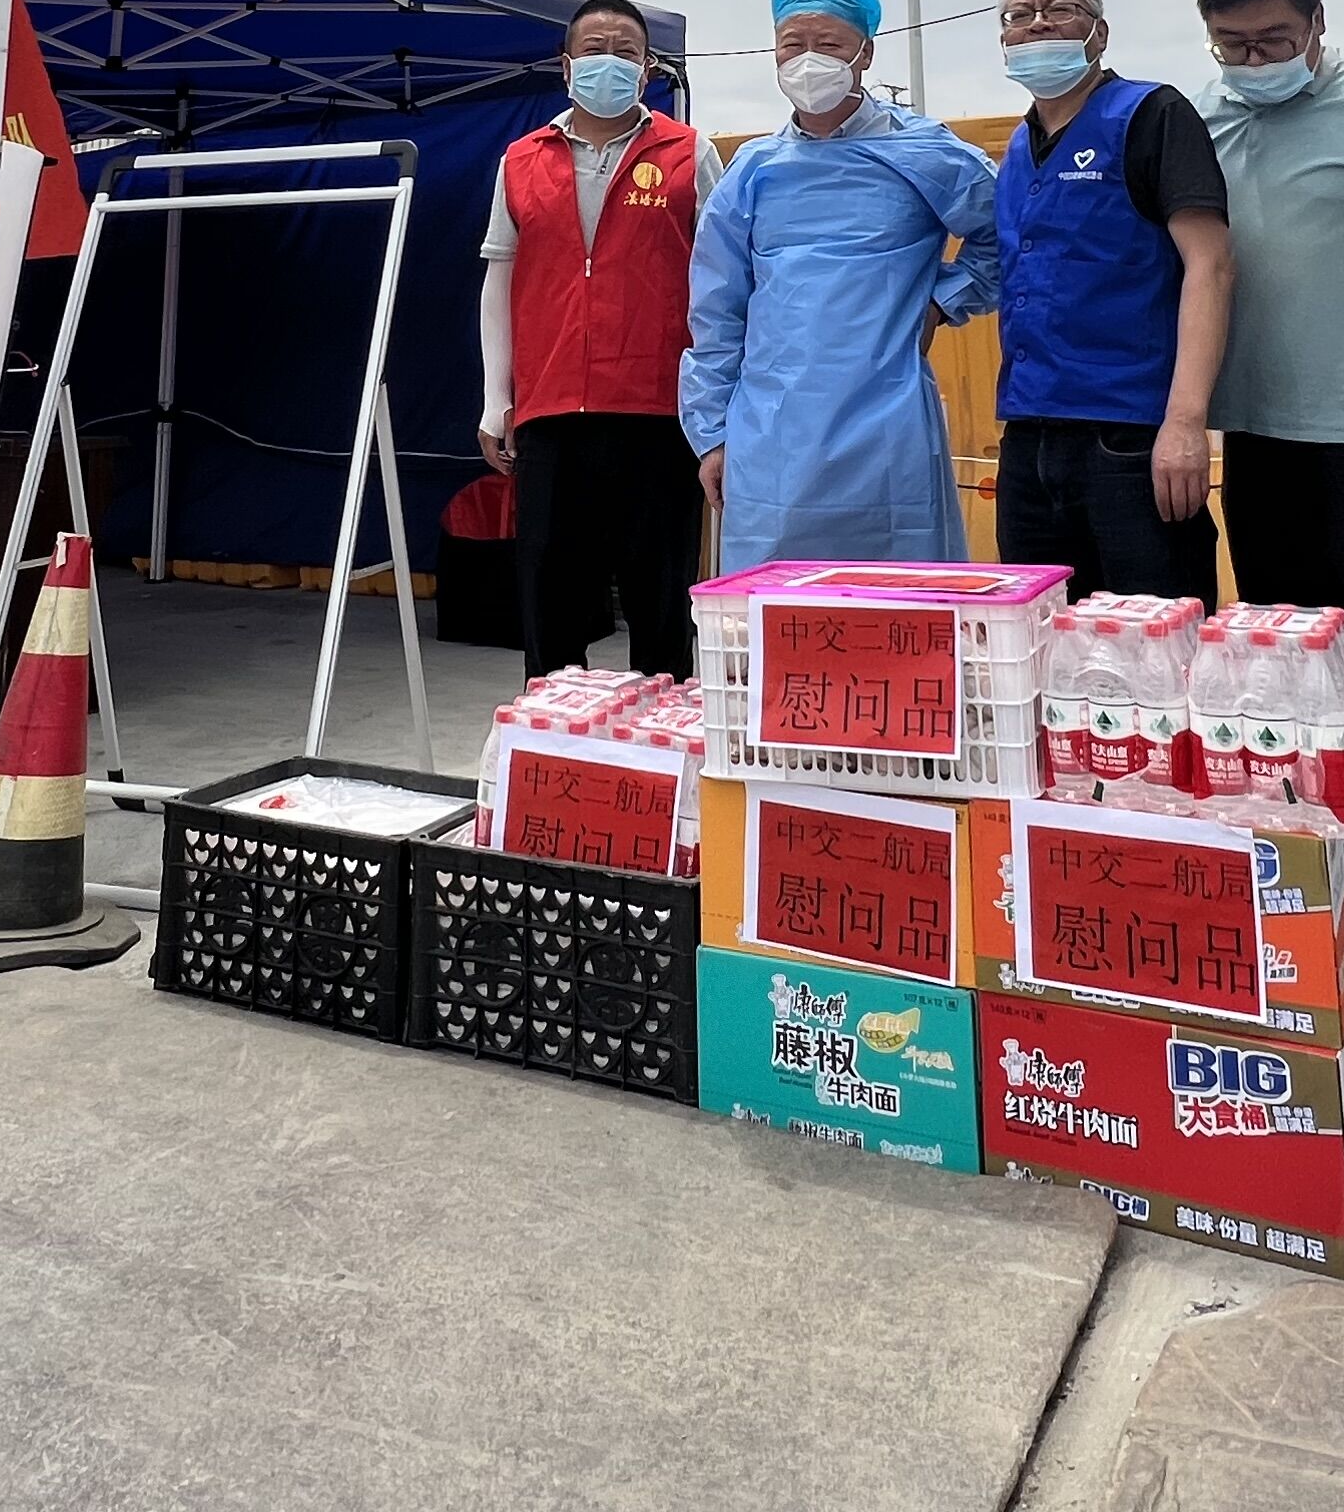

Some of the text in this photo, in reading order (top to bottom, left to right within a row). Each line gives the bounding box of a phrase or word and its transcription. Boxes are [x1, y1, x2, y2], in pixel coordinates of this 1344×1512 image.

[780, 613, 954, 658] 中交二航局
[779, 671, 954, 739] 慰问品
[523, 761, 675, 820] 中交二航局
[776, 814, 950, 881] 中交二航局
[1048, 838, 1253, 904] 中交二航局
[775, 871, 949, 964] 慰问品
[1050, 902, 1257, 997] 慰问品
[774, 1022, 858, 1079] 藤椒
[1169, 1040, 1290, 1101] BIG
[827, 1076, 898, 1114] 牛肉面
[1004, 1089, 1139, 1150] 红烧牛肉面
[1182, 1096, 1268, 1133] 大食桶
[1265, 1228, 1327, 1263] 超满足
